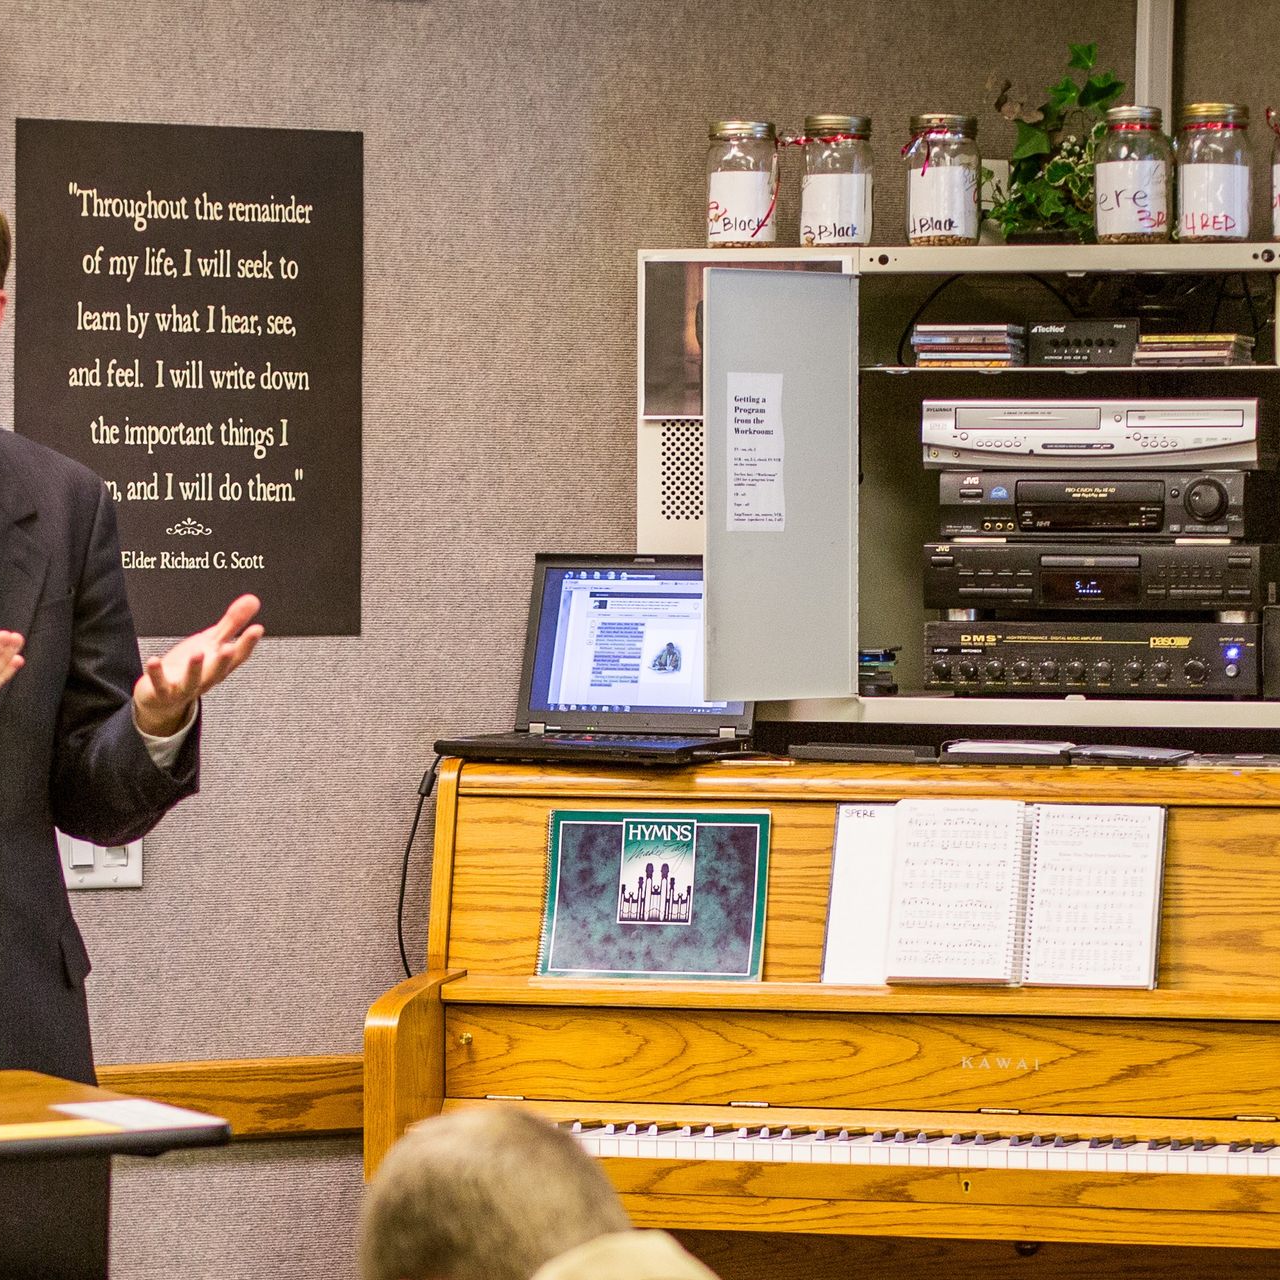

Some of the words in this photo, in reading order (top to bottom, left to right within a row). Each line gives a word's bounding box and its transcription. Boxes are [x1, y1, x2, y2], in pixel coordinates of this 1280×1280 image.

[68, 181, 190, 232] "Throughout
[193, 191, 224, 221] the
[227, 194, 313, 224] remainder
[818, 223, 859, 240] Black
[919, 217, 959, 232] Black
[1200, 213, 1236, 232] RED
[82, 245, 105, 275] of
[108, 255, 140, 283] my
[144, 246, 178, 279] life,
[182, 248, 192, 277] I
[196, 248, 231, 278] will
[236, 249, 275, 280] seek
[279, 256, 299, 280] to
[76, 300, 122, 332] learn
[126, 303, 150, 340] by
[154, 303, 201, 334] what
[205, 305, 216, 334] I
[220, 304, 262, 337] hear,
[266, 315, 297, 337] see,
[68, 357, 102, 387] and
[106, 358, 144, 388] feel.
[154, 359, 165, 389] I
[169, 359, 204, 390] will
[209, 361, 256, 390] write
[259, 361, 310, 391] down
[734, 406, 766, 414] Program
[89, 415, 120, 445] the
[124, 416, 215, 455] important
[219, 417, 275, 460] things
[279, 418, 289, 447] I
[126, 471, 160, 501] and
[163, 472, 174, 501] I
[178, 472, 214, 502] will
[218, 472, 243, 502] do
[247, 468, 304, 503] them."
[963, 477, 979, 485] JVC
[120, 550, 158, 570] Elder
[159, 551, 210, 570] Richard
[212, 551, 228, 570] G.
[230, 551, 265, 570] Scott
[629, 824, 692, 841] HYMNS
[961, 1056, 1039, 1071] KAWAI
